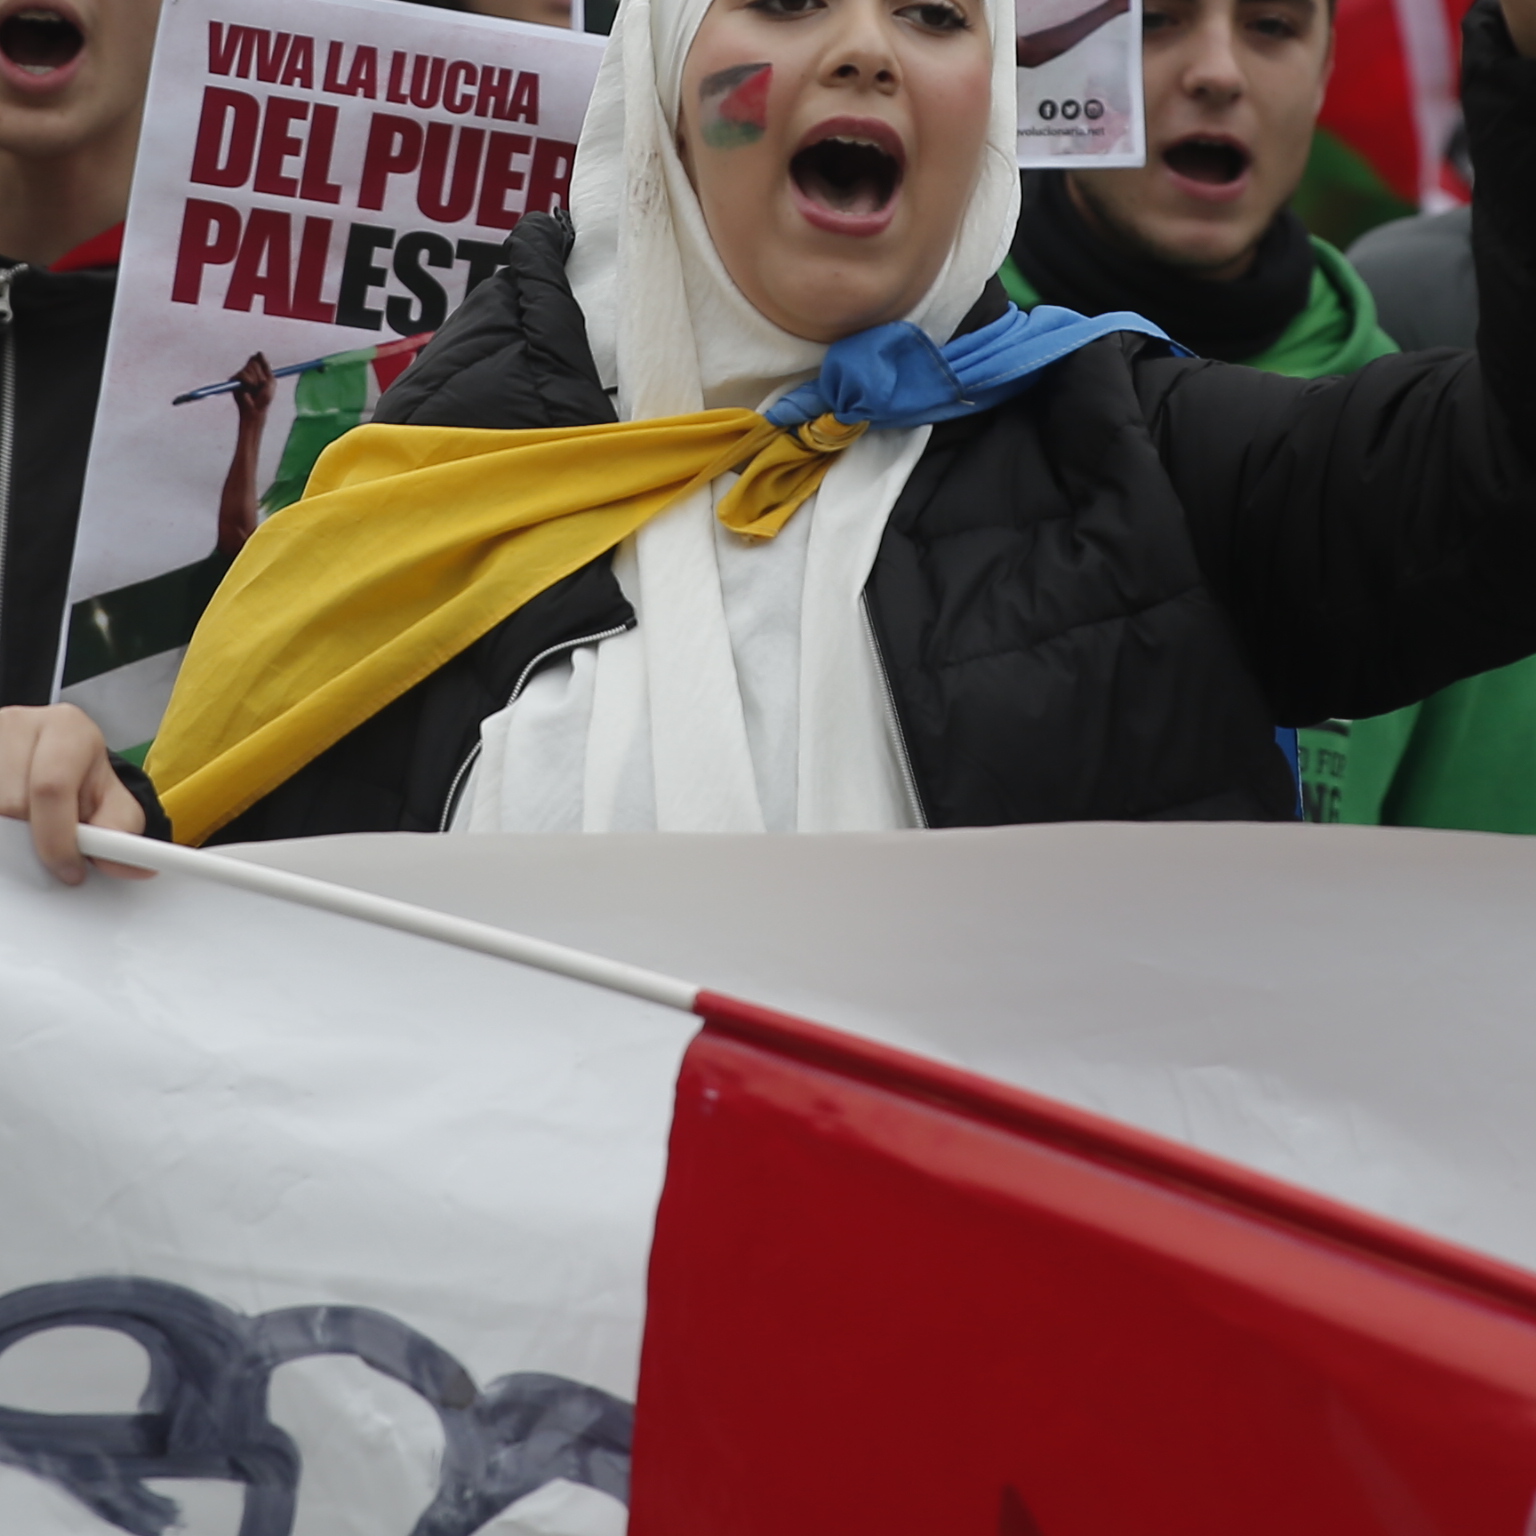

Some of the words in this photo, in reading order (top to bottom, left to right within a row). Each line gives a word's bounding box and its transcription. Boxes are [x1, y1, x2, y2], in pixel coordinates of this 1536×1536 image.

[208, 21, 313, 89] VIVA
[323, 41, 378, 100] LA
[386, 50, 540, 125] LUCHA
[189, 86, 341, 206] DEL
